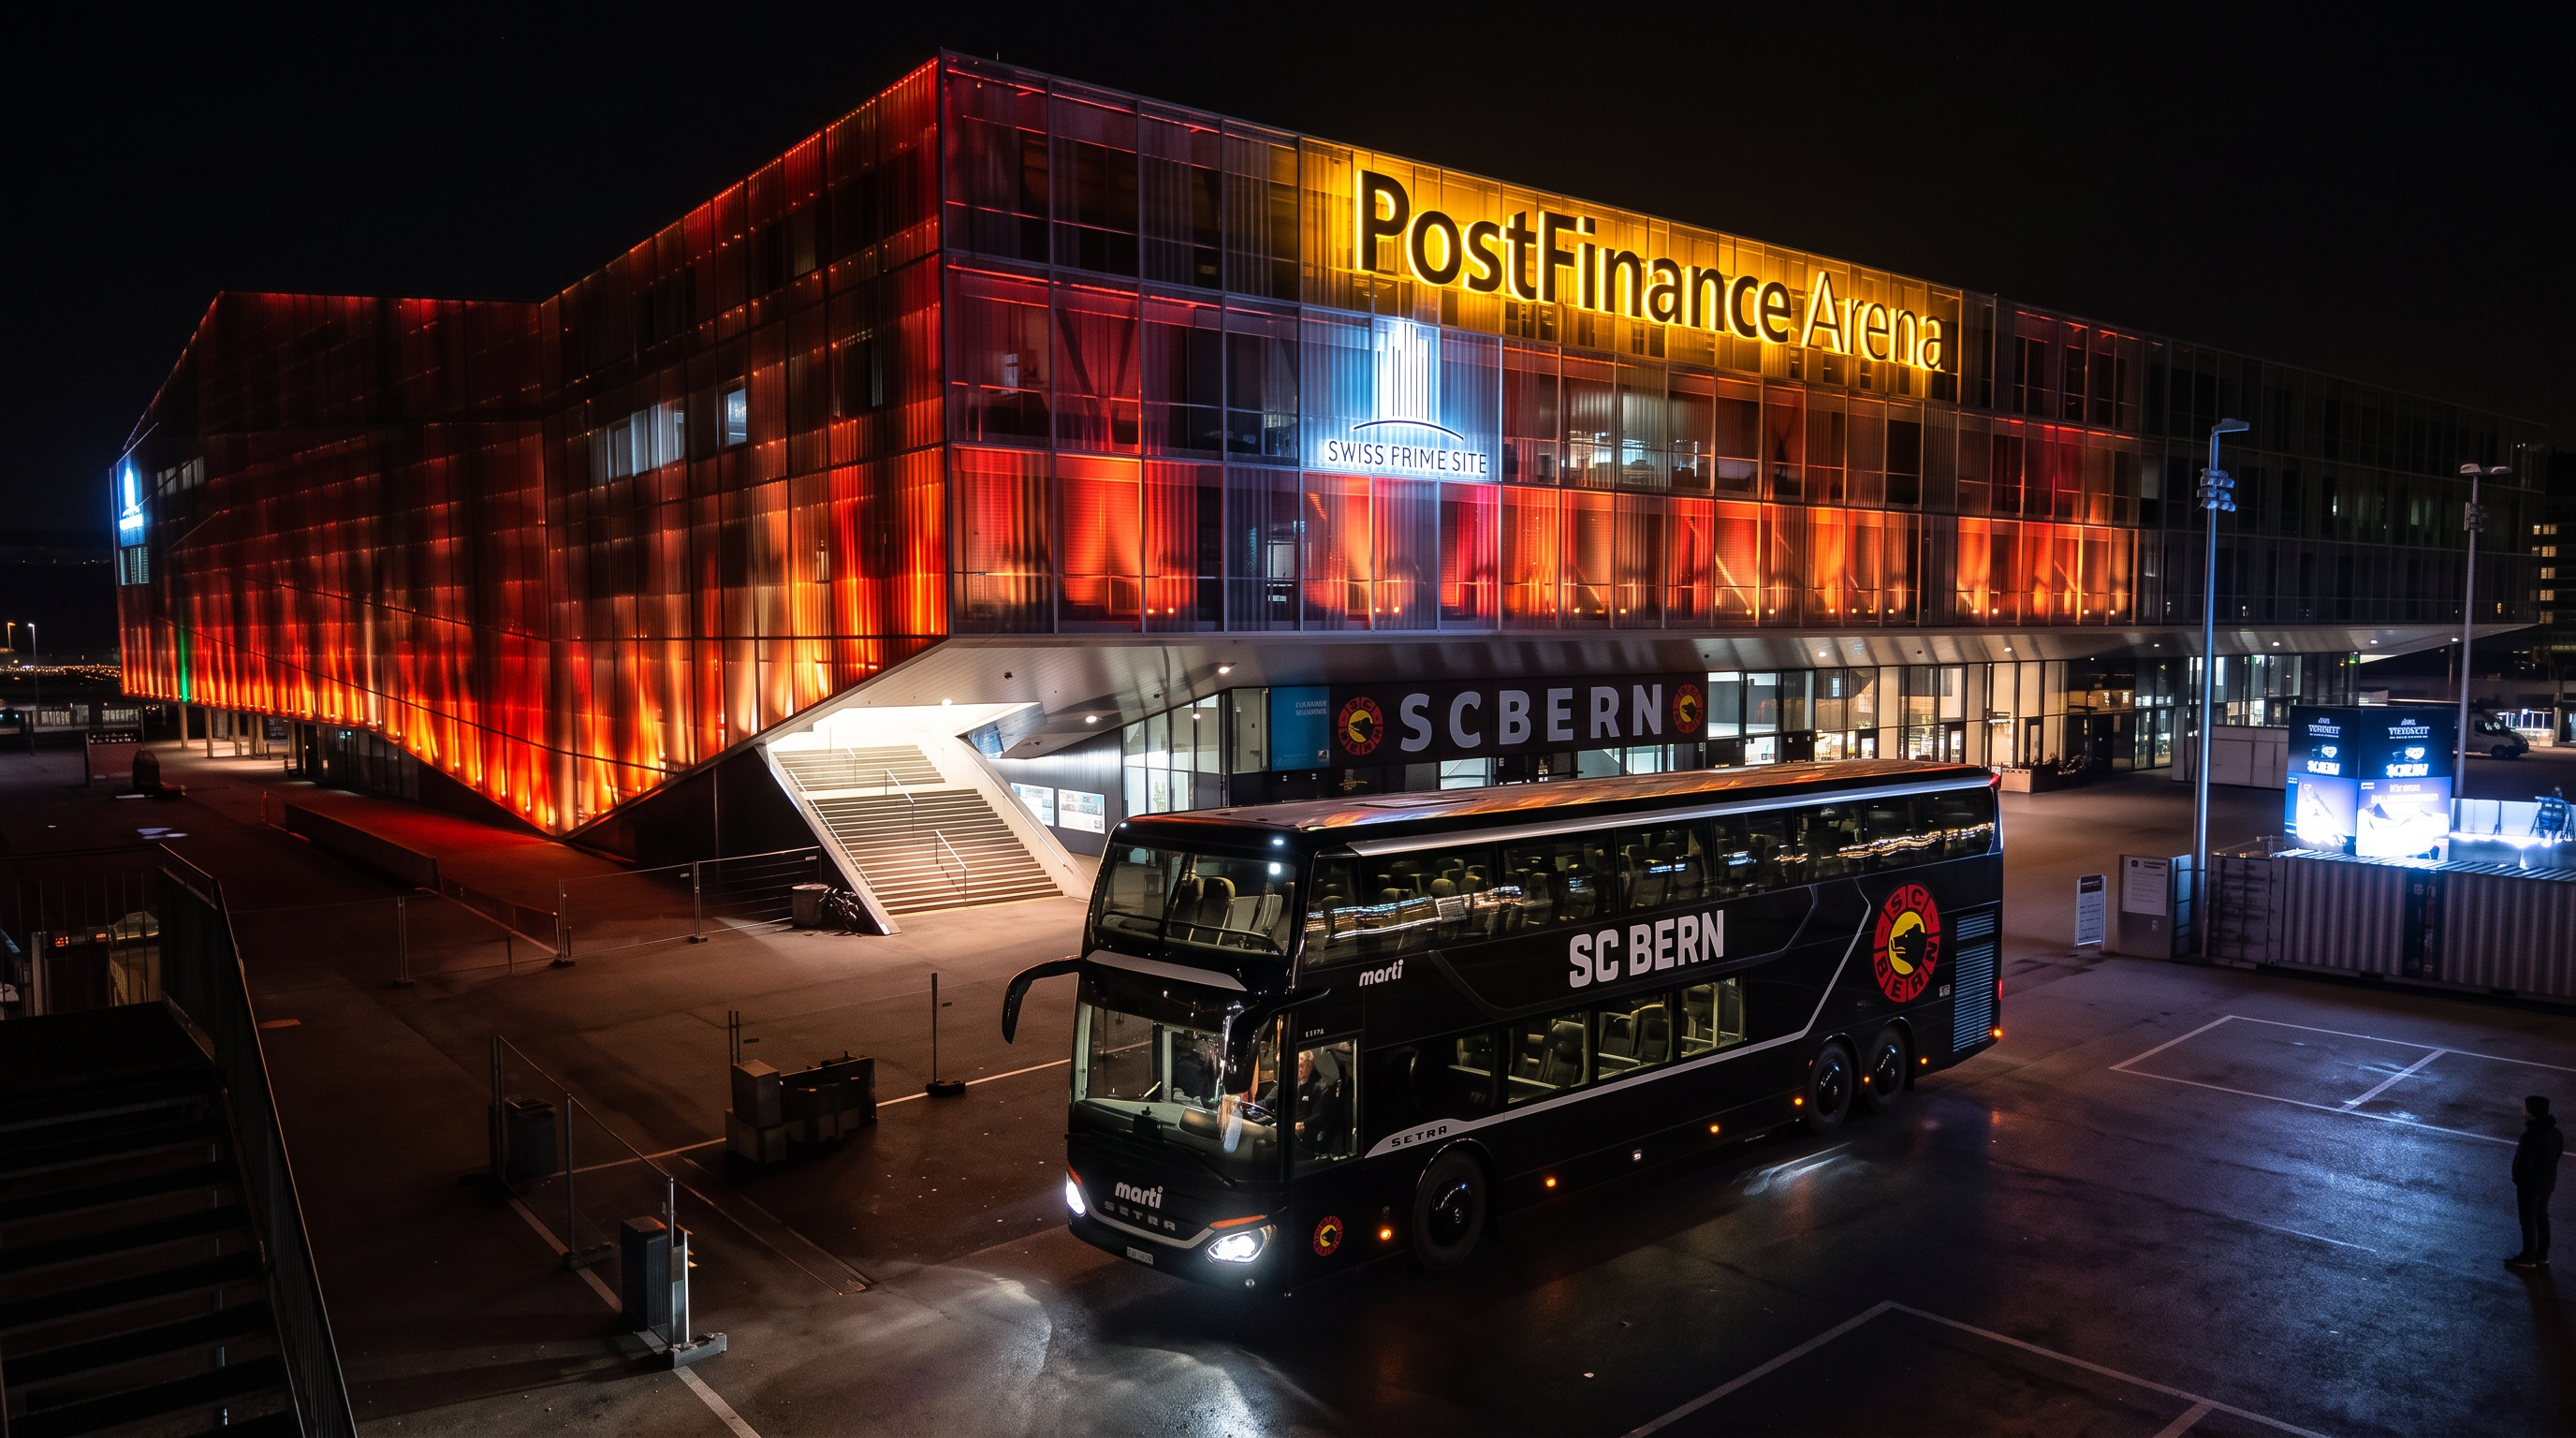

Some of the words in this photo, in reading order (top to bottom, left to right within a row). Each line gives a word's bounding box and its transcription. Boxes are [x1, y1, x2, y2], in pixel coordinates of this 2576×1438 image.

[1356, 169, 1792, 345] PostFinance
[1801, 271, 1943, 372] Arena
[1328, 440, 1383, 465] SWISS
[1452, 451, 1487, 474] SITE
[1569, 929, 1619, 989] SC
[1630, 909, 1724, 976] BERN
[1358, 959, 1404, 987] marti
[1391, 1125, 1447, 1148] SETRA
[1115, 1181, 1164, 1209] marti
[1105, 1200, 1176, 1231] SETRA
